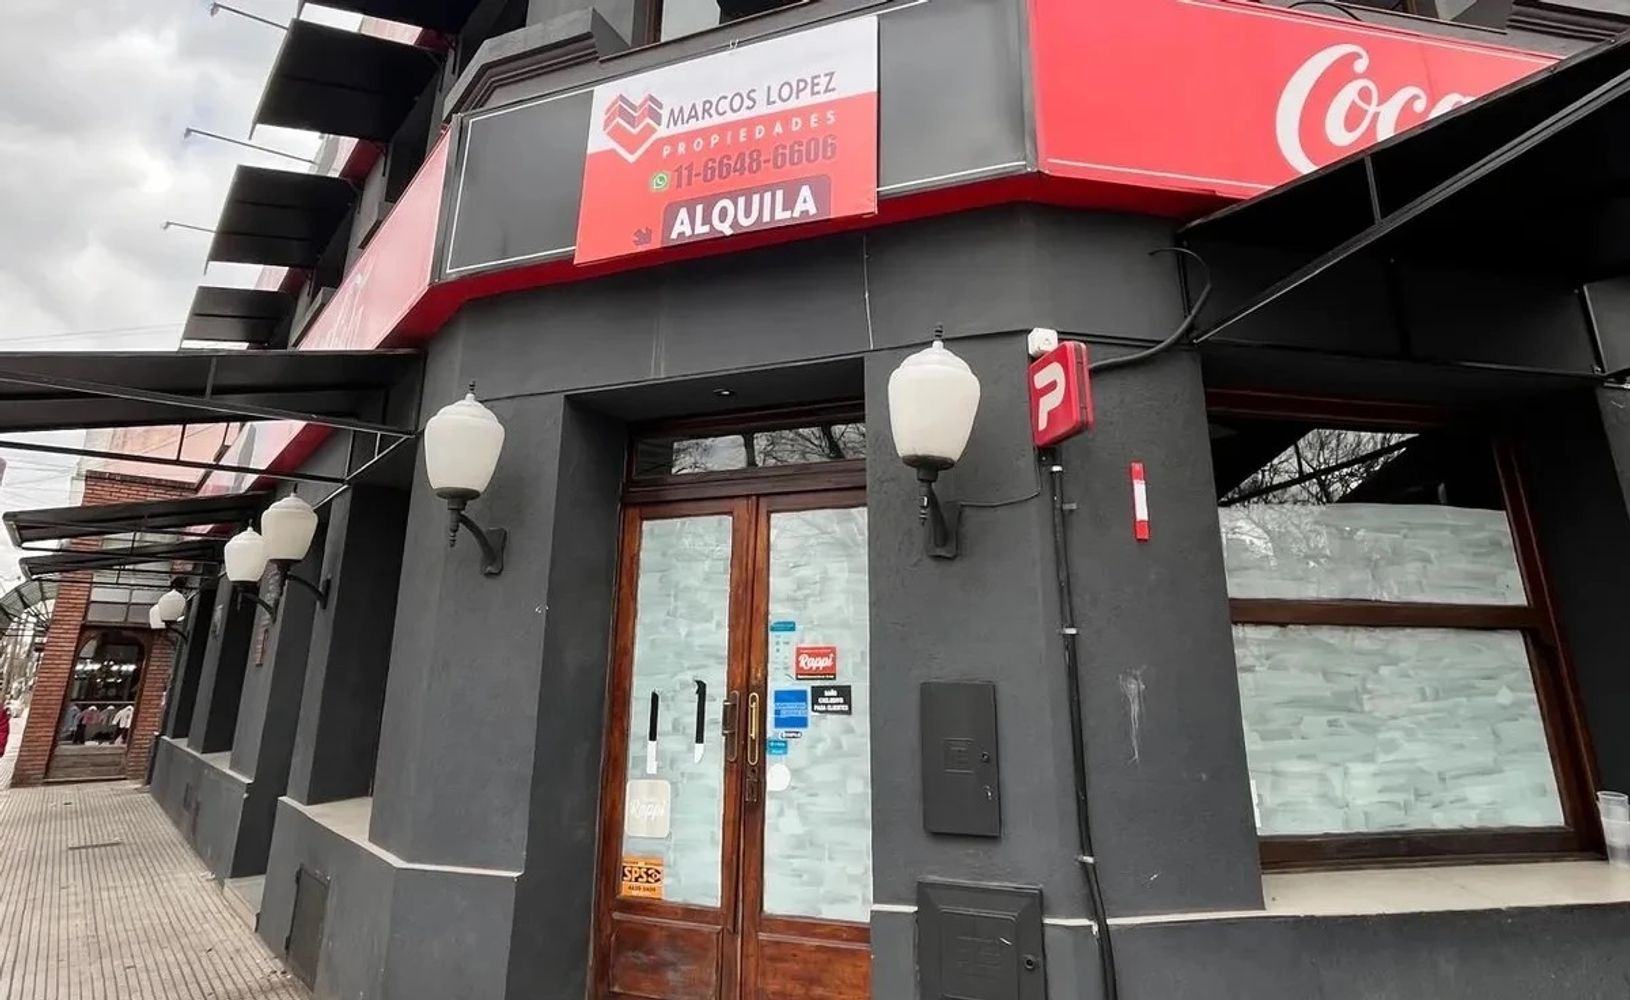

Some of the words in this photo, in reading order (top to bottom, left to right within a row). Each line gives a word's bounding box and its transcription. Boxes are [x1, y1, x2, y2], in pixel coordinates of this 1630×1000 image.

[666, 89, 757, 129] MARCOS
[766, 71, 837, 106] LOPEZ
[662, 110, 837, 158] PROPIEDADES
[673, 134, 838, 189] 11-6648-6606
[670, 184, 818, 239] ALQUILA
[798, 653, 834, 670] Rappi
